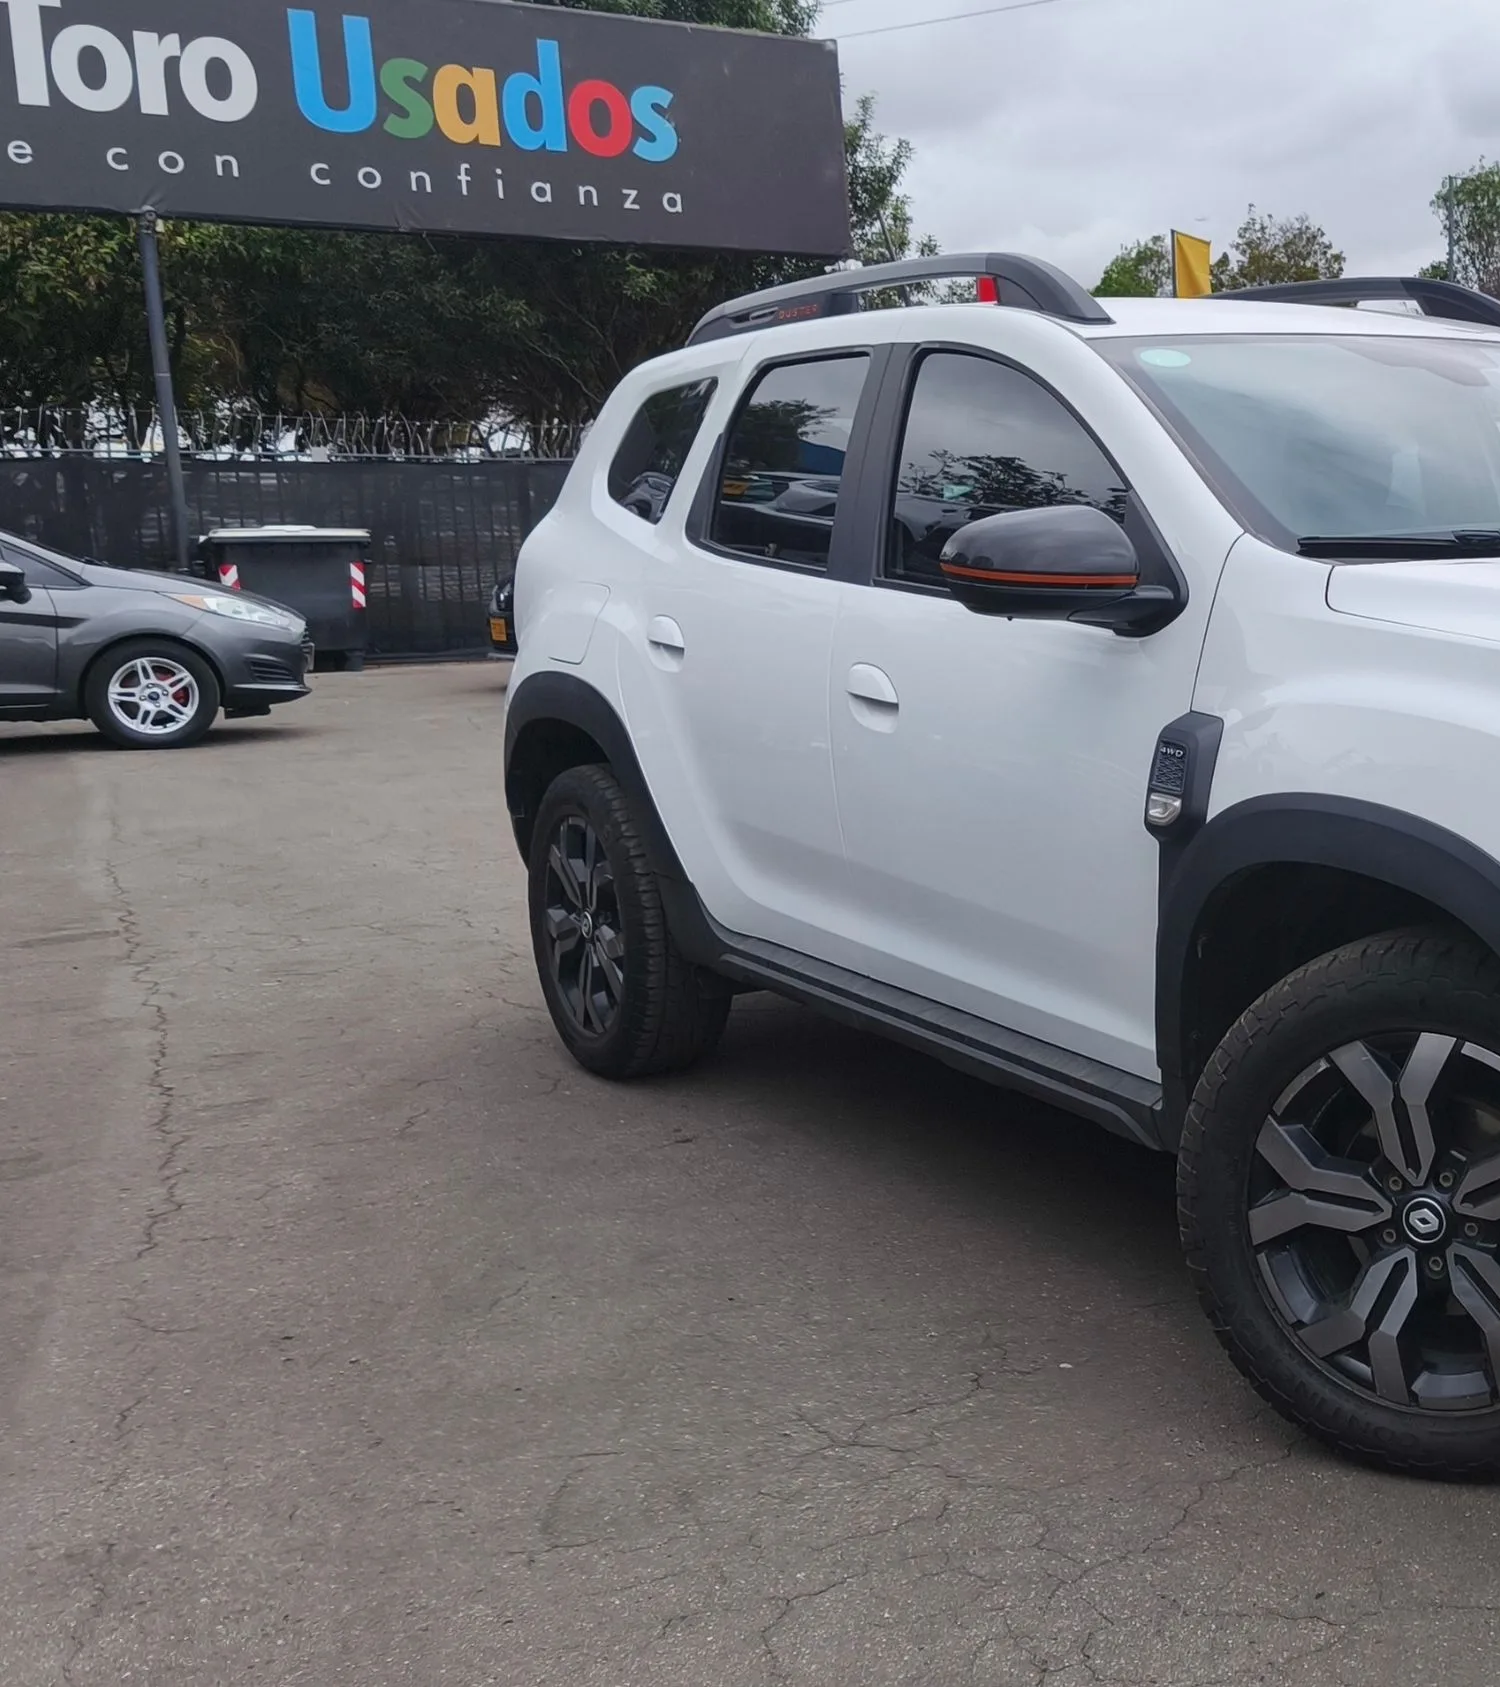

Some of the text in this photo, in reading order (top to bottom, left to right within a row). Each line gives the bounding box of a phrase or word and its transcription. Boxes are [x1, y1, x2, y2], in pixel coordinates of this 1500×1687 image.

[0, 0, 679, 162] Toro Usados
[106, 147, 240, 178] con
[310, 162, 683, 214] confianza
[1160, 746, 1183, 757] 4WD
